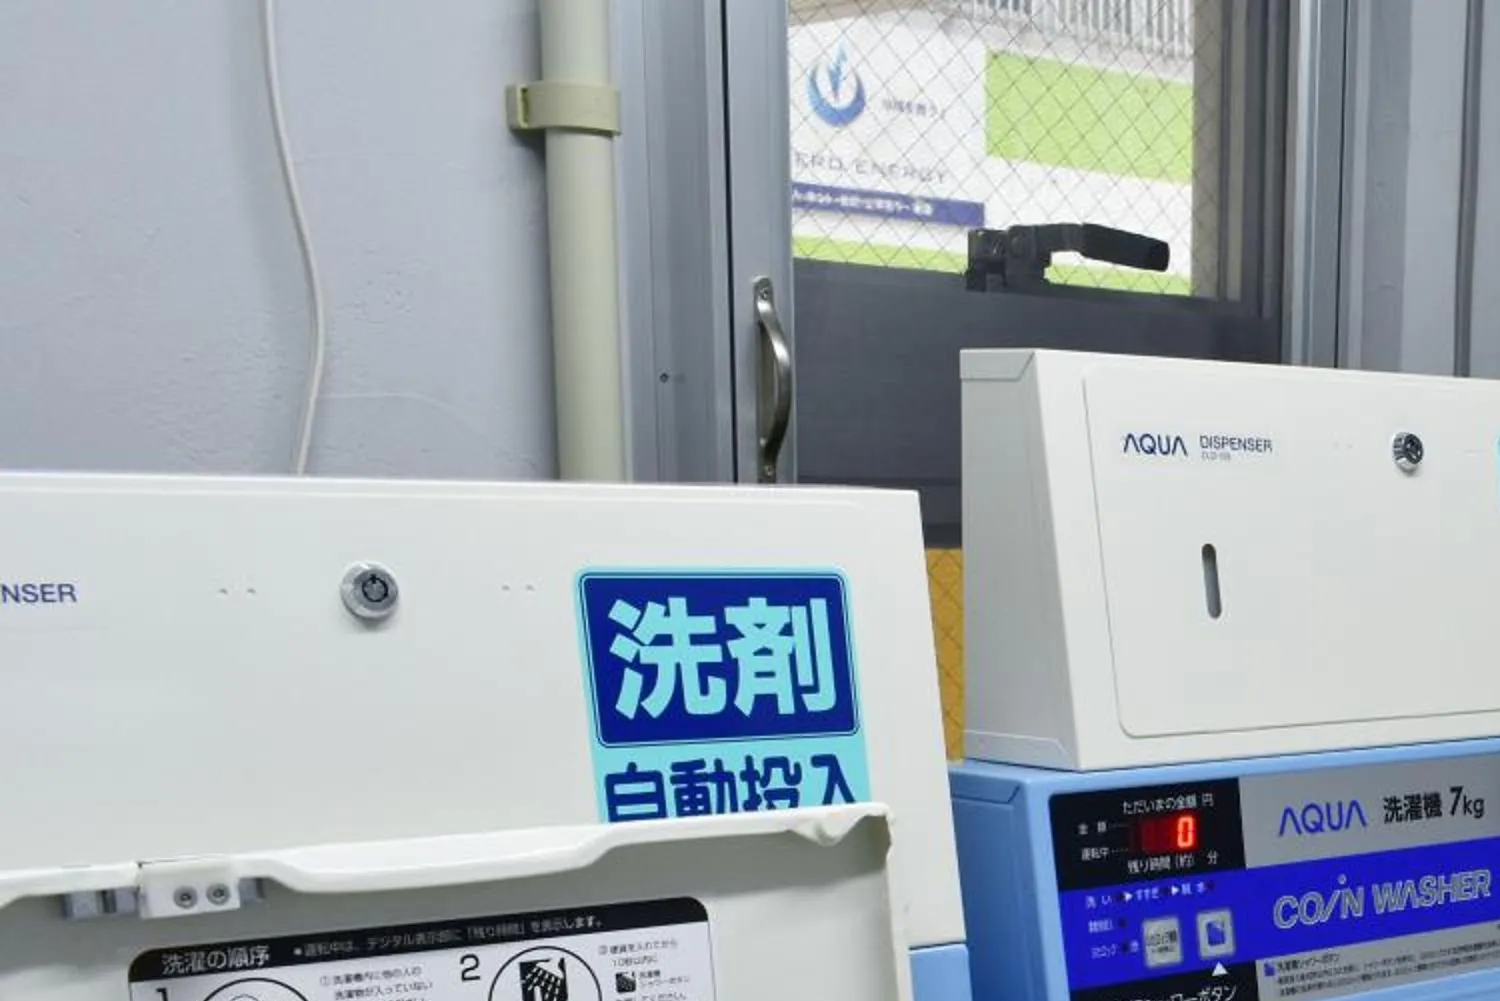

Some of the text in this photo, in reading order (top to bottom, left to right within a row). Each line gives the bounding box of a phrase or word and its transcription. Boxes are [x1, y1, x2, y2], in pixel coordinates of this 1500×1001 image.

[1123, 433, 1188, 457] AQUA
[1200, 435, 1273, 453] DISPENSER
[0, 583, 77, 604] NSER
[607, 597, 838, 720] 洗剤
[604, 752, 857, 823] 自動投入
[1383, 786, 1485, 824] 洗濯機 7kg
[1176, 816, 1196, 848] 0
[1278, 799, 1368, 837] AQUA
[1372, 869, 1491, 915] WASHER
[161, 944, 270, 976] 洗濯の順序
[459, 953, 482, 983] 2
